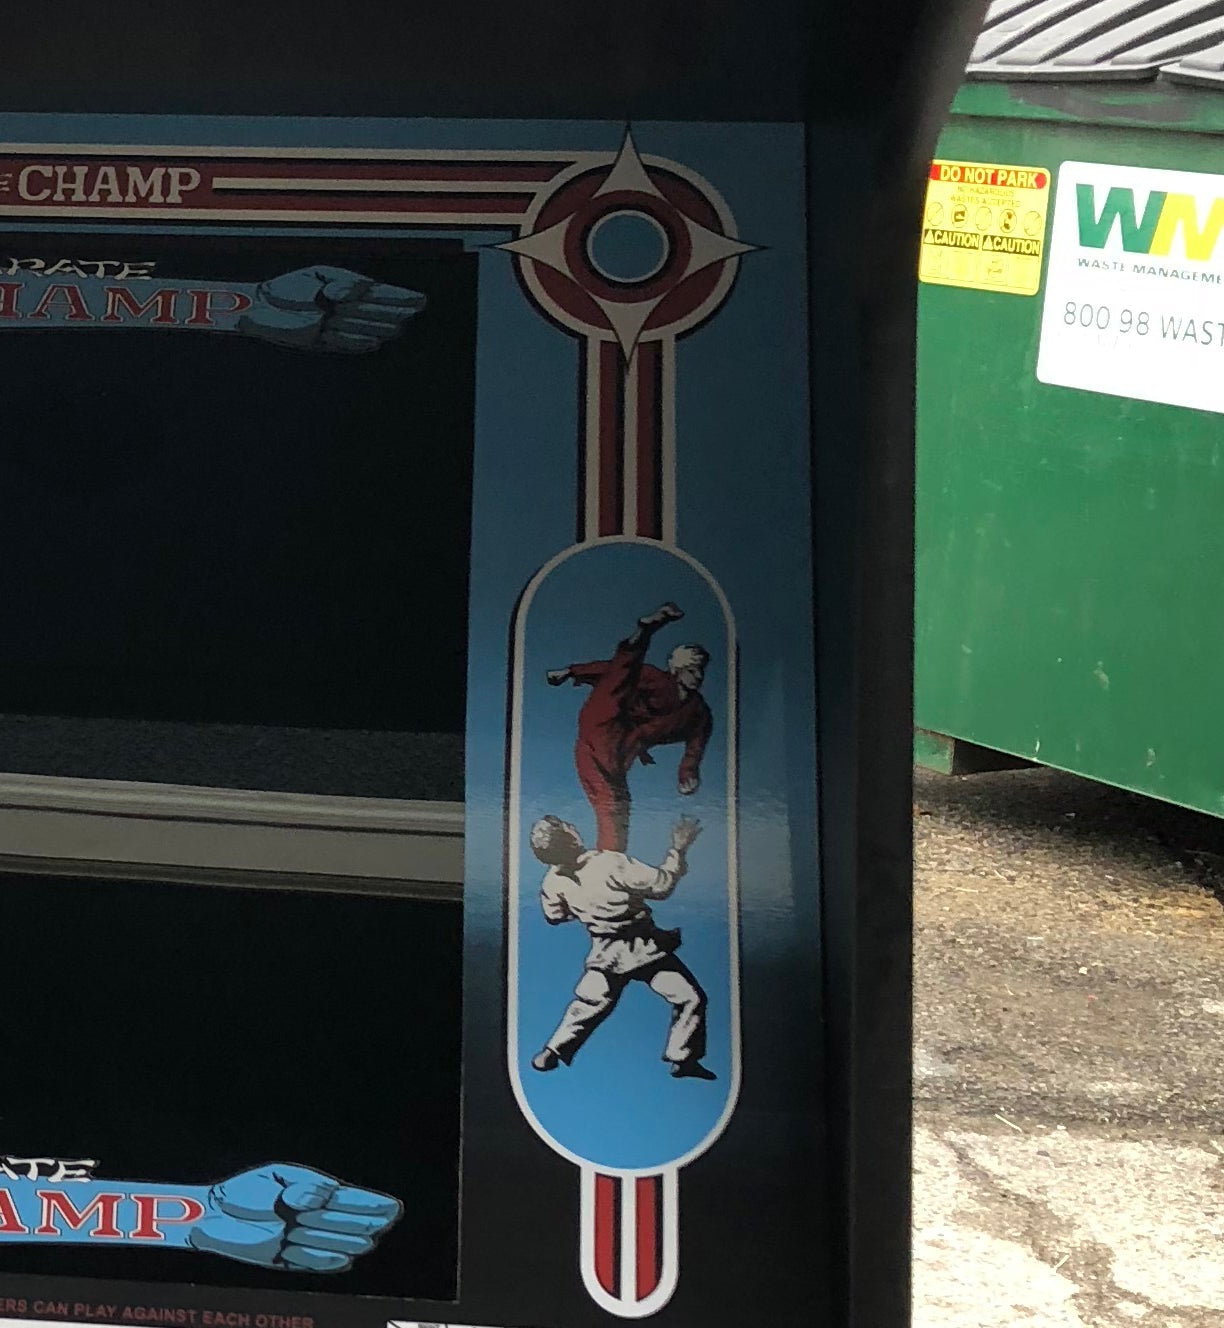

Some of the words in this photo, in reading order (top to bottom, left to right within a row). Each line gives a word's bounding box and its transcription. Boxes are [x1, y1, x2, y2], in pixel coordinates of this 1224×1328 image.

[18, 165, 201, 204] CHAMP
[940, 165, 961, 182] DO
[964, 168, 995, 184] NOT
[998, 170, 1037, 188] PARK
[935, 231, 979, 248] CAUTION
[994, 238, 1040, 255] CAUTION
[1078, 258, 1125, 272] WASTE
[1064, 301, 1110, 329] 800
[1120, 309, 1149, 336] 98
[33, 1300, 71, 1315] CAN
[75, 1301, 117, 1319] PLAY
[122, 1306, 197, 1323] AGAINST
[202, 1310, 250, 1327] EACH
